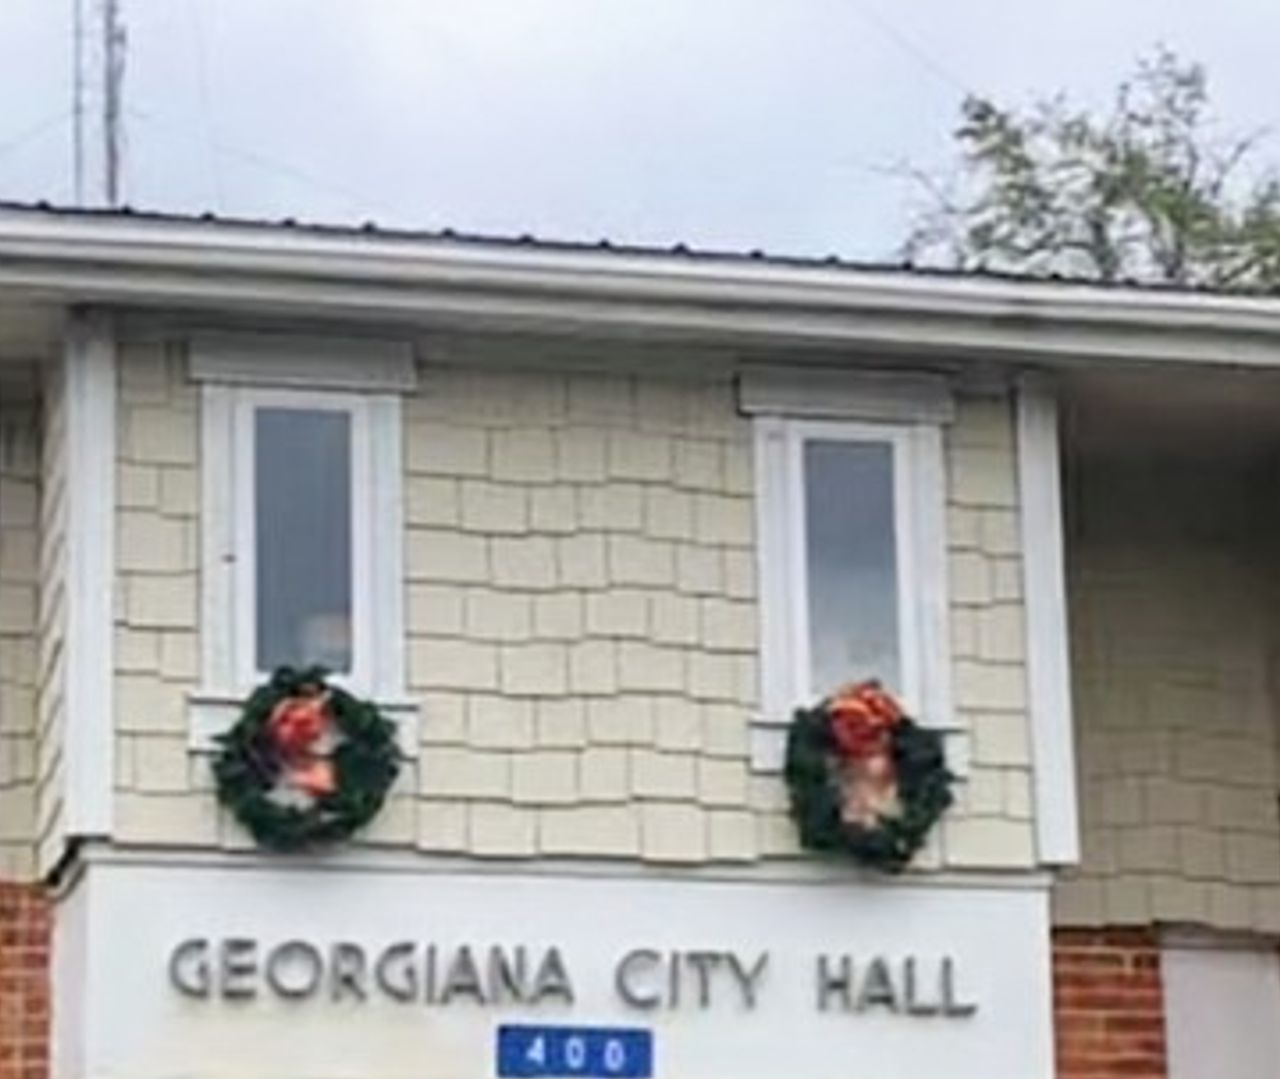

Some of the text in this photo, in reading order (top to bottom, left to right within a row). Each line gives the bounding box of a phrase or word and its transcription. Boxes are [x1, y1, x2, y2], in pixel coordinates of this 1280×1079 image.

[168, 937, 978, 1018] GEORGIANA CITY HALL
[526, 1035, 625, 1072] 400
